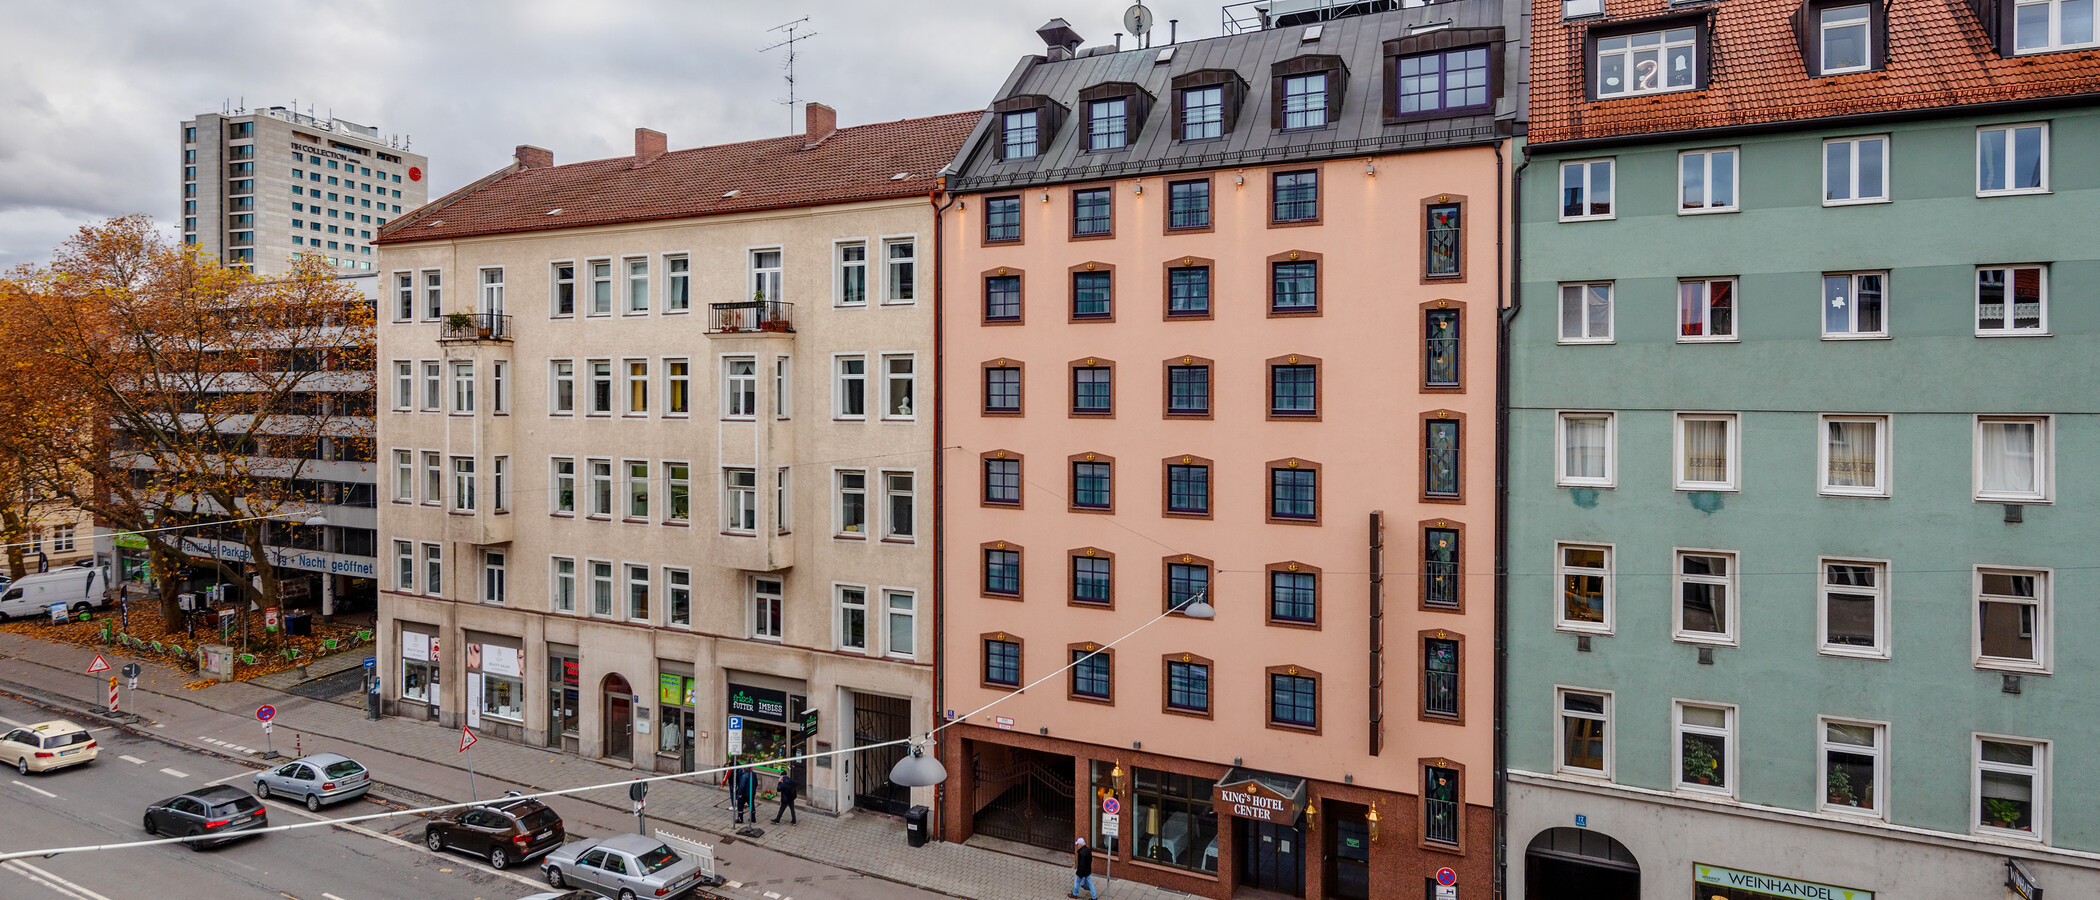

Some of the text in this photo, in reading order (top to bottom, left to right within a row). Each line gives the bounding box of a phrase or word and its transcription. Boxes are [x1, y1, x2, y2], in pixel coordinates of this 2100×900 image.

[302, 145, 347, 161] COLLECTION
[299, 555, 326, 569] Nacht
[332, 560, 373, 575] geöffnet
[758, 702, 783, 714] IMBISS
[730, 717, 739, 729] P
[1252, 795, 1284, 811] HOTEL
[1234, 804, 1271, 820] CENTER
[1728, 872, 1834, 900] WEINHANDEL
